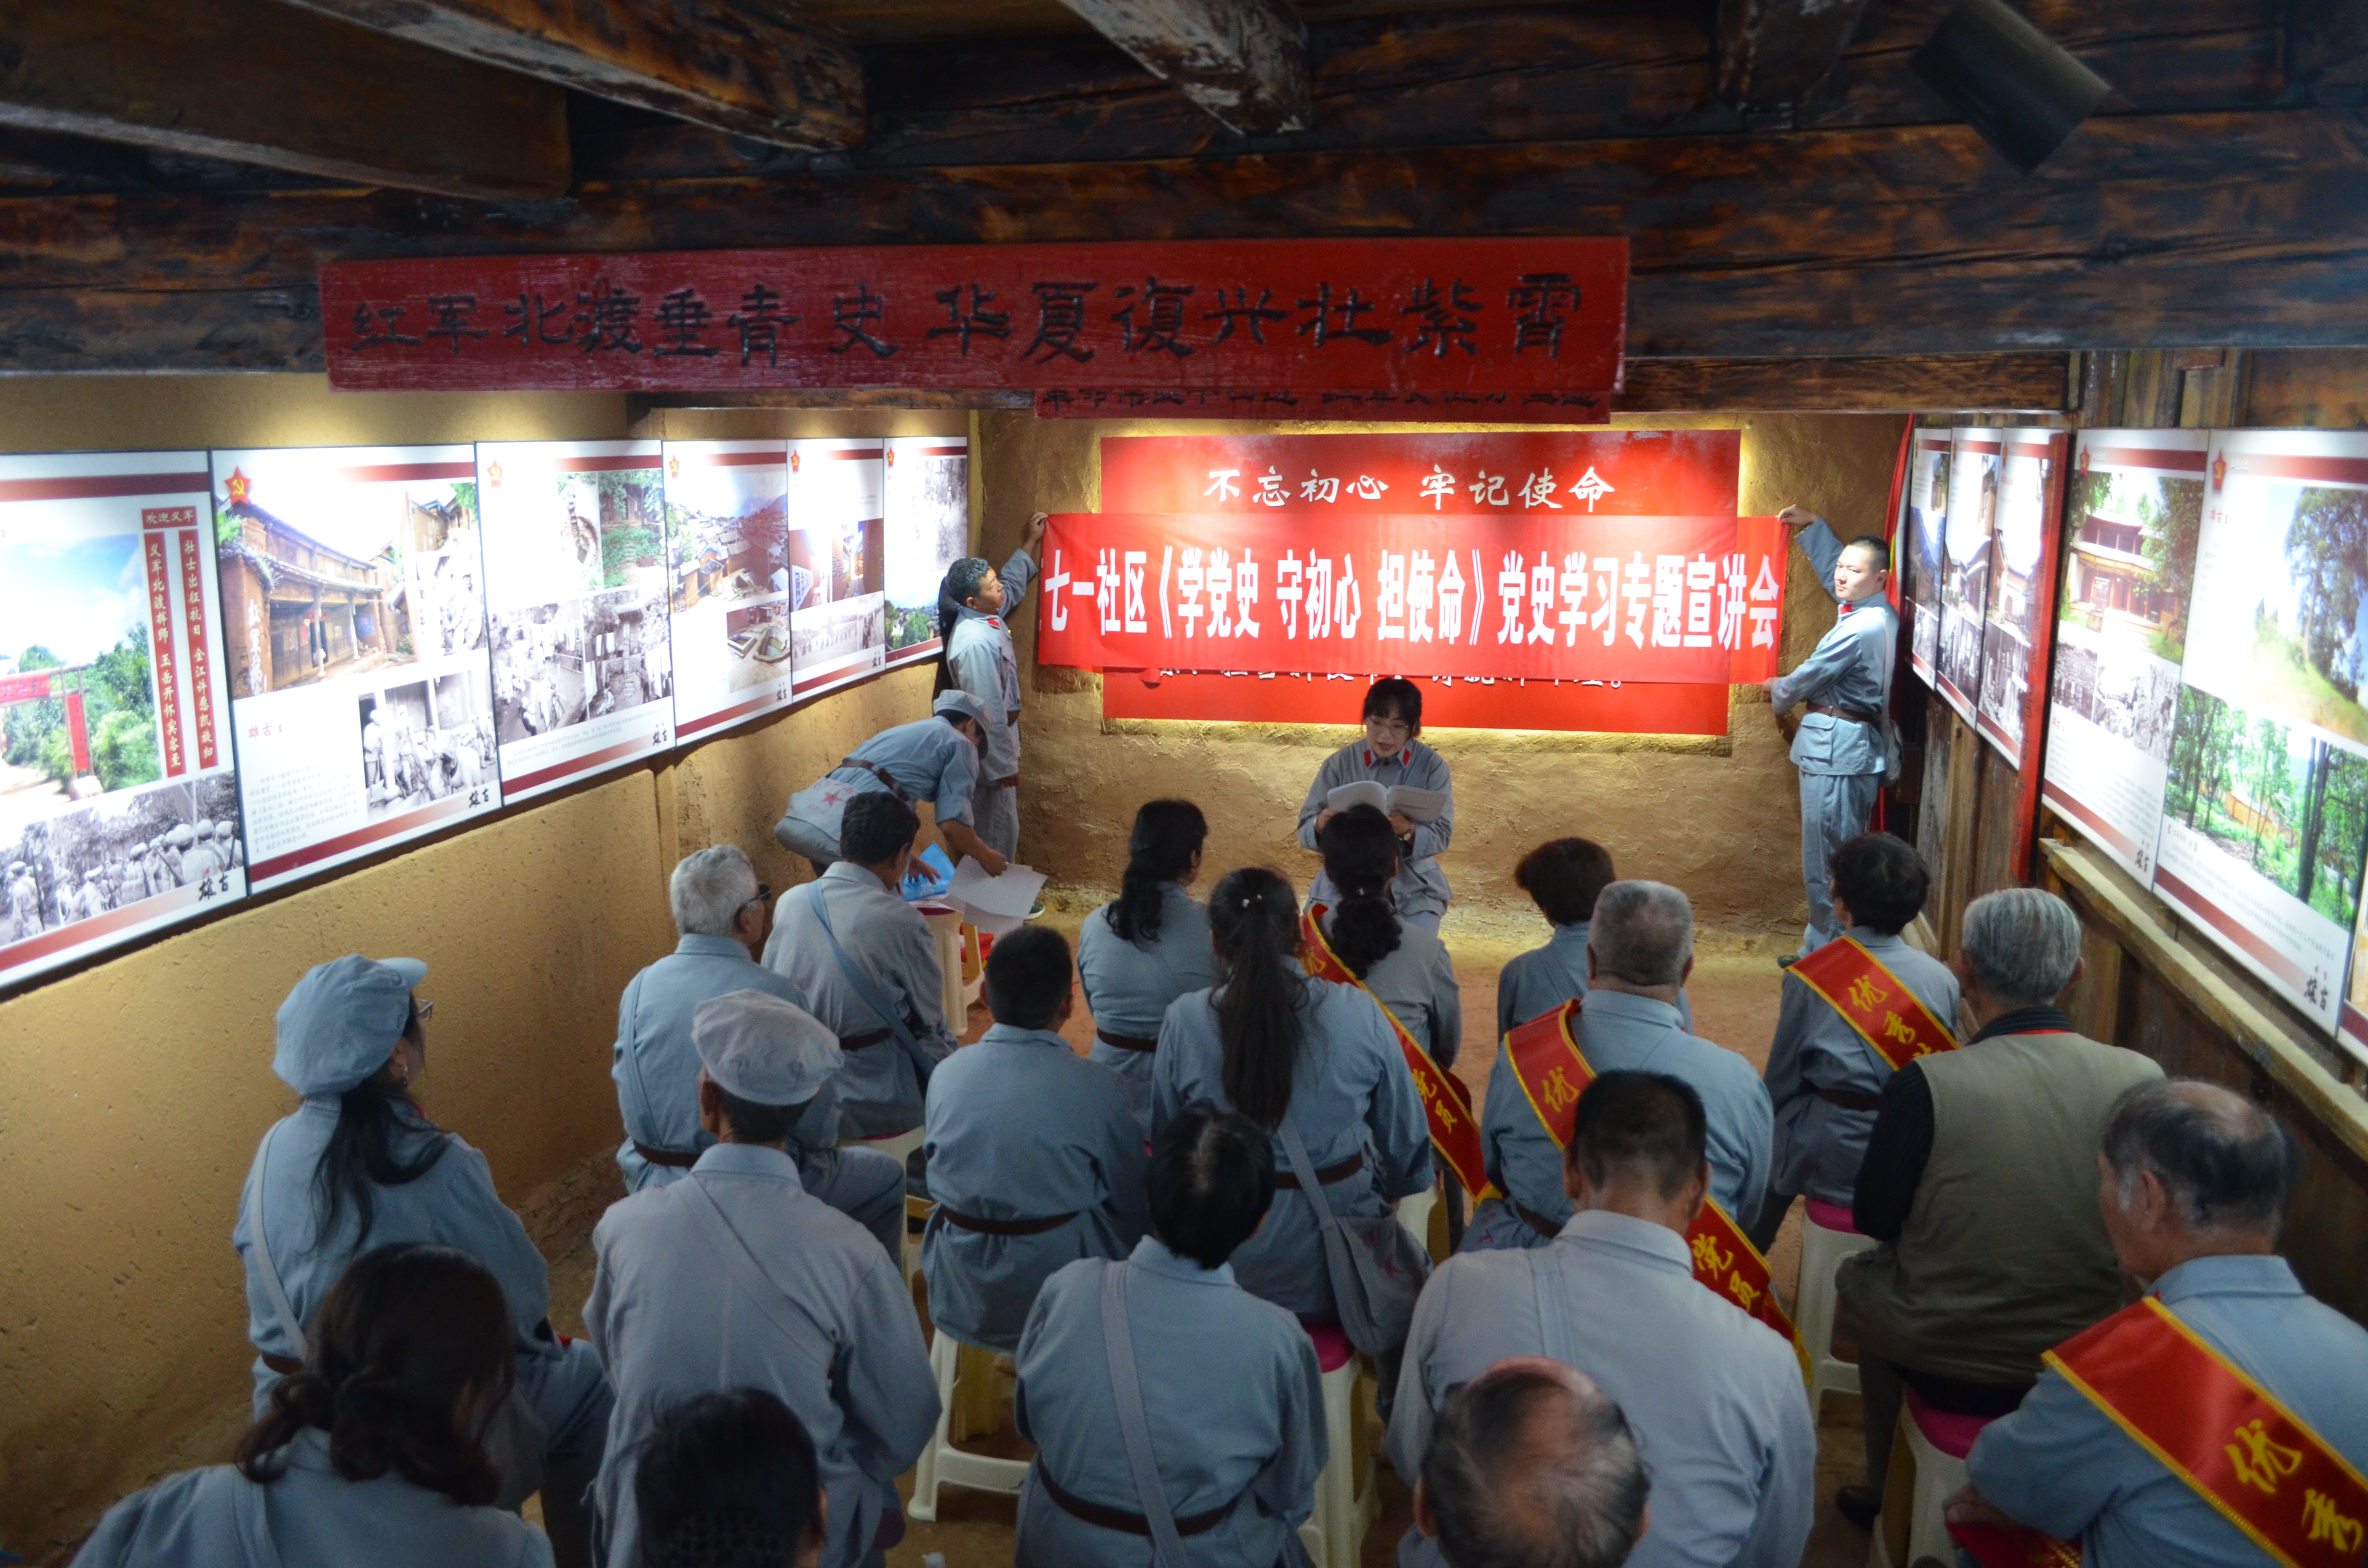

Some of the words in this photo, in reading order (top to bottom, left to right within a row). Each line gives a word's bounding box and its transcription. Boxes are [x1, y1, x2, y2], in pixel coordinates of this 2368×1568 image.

[1204, 465, 1390, 507] 不忘初心
[1419, 465, 1616, 512] 牢记使命
[147, 510, 194, 524] 欢迎义军
[1039, 546, 1259, 640] 七一社区《学党史
[1276, 549, 1362, 641] 守初心
